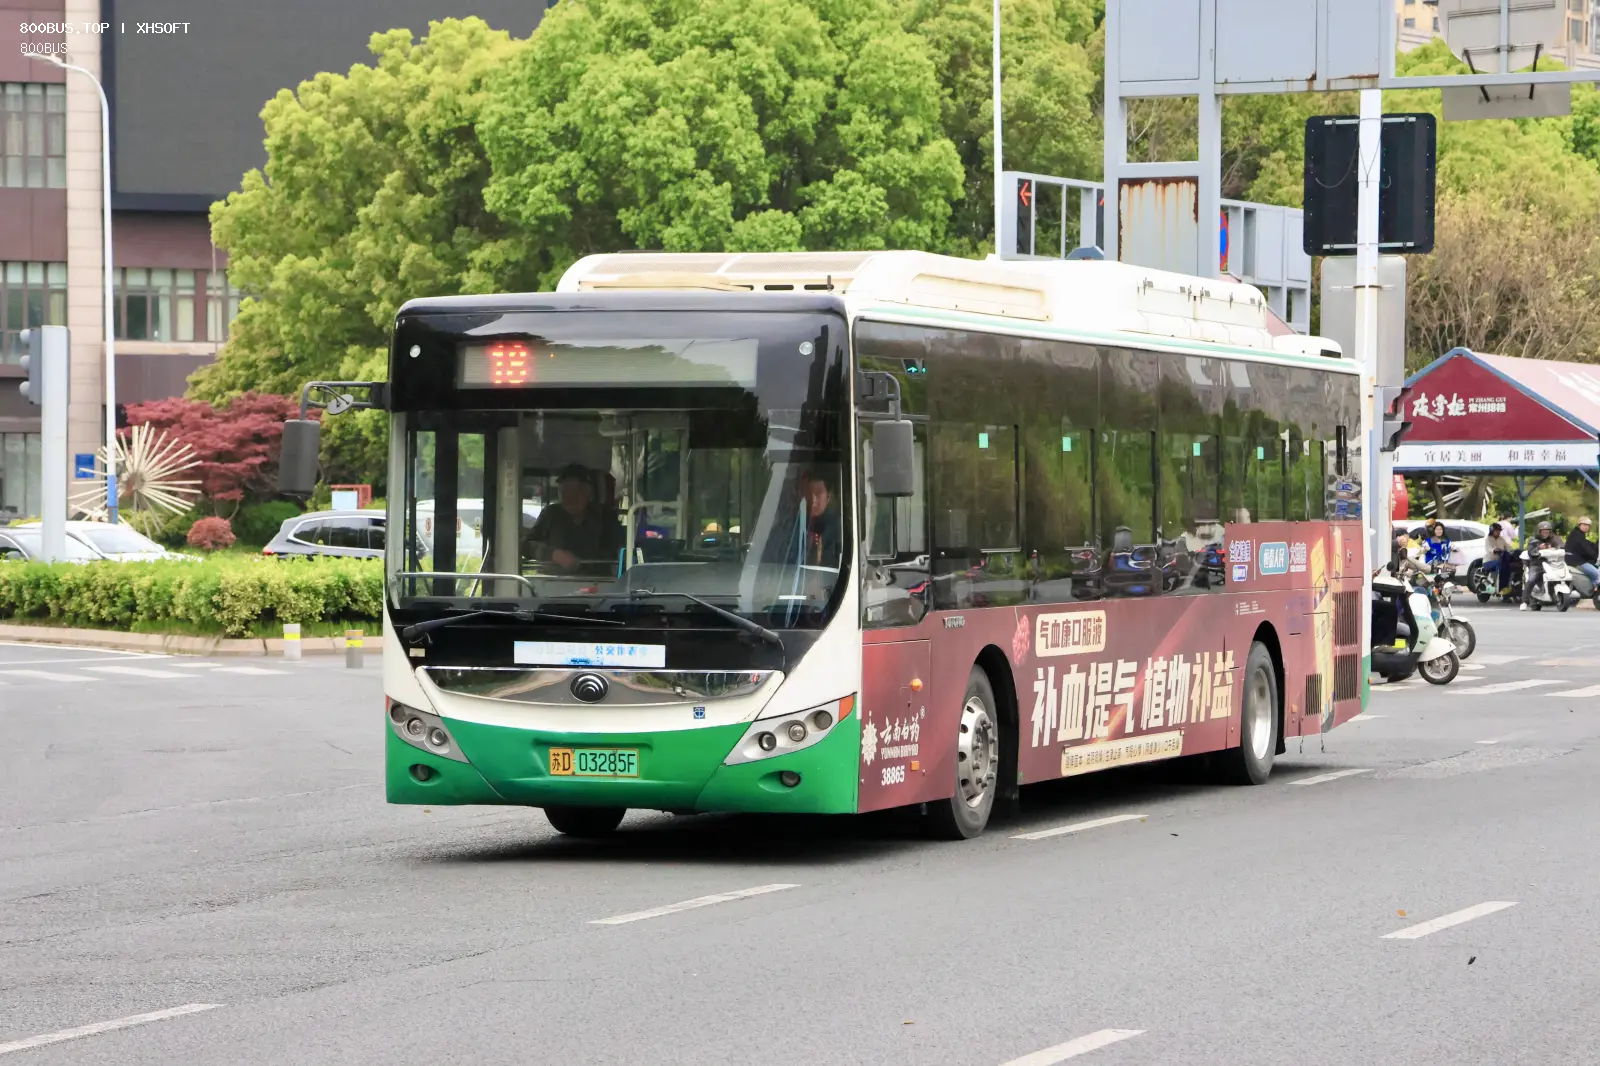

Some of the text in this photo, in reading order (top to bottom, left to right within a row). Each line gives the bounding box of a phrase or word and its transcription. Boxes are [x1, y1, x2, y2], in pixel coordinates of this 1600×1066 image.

[1424, 449, 1567, 462] 宜居美丽 和谐幸福
[1040, 616, 1103, 649] 气血康口服液
[1031, 650, 1235, 748] 补血提气 植物补益
[880, 712, 920, 745] 云南白药
[881, 765, 905, 786] 38865
